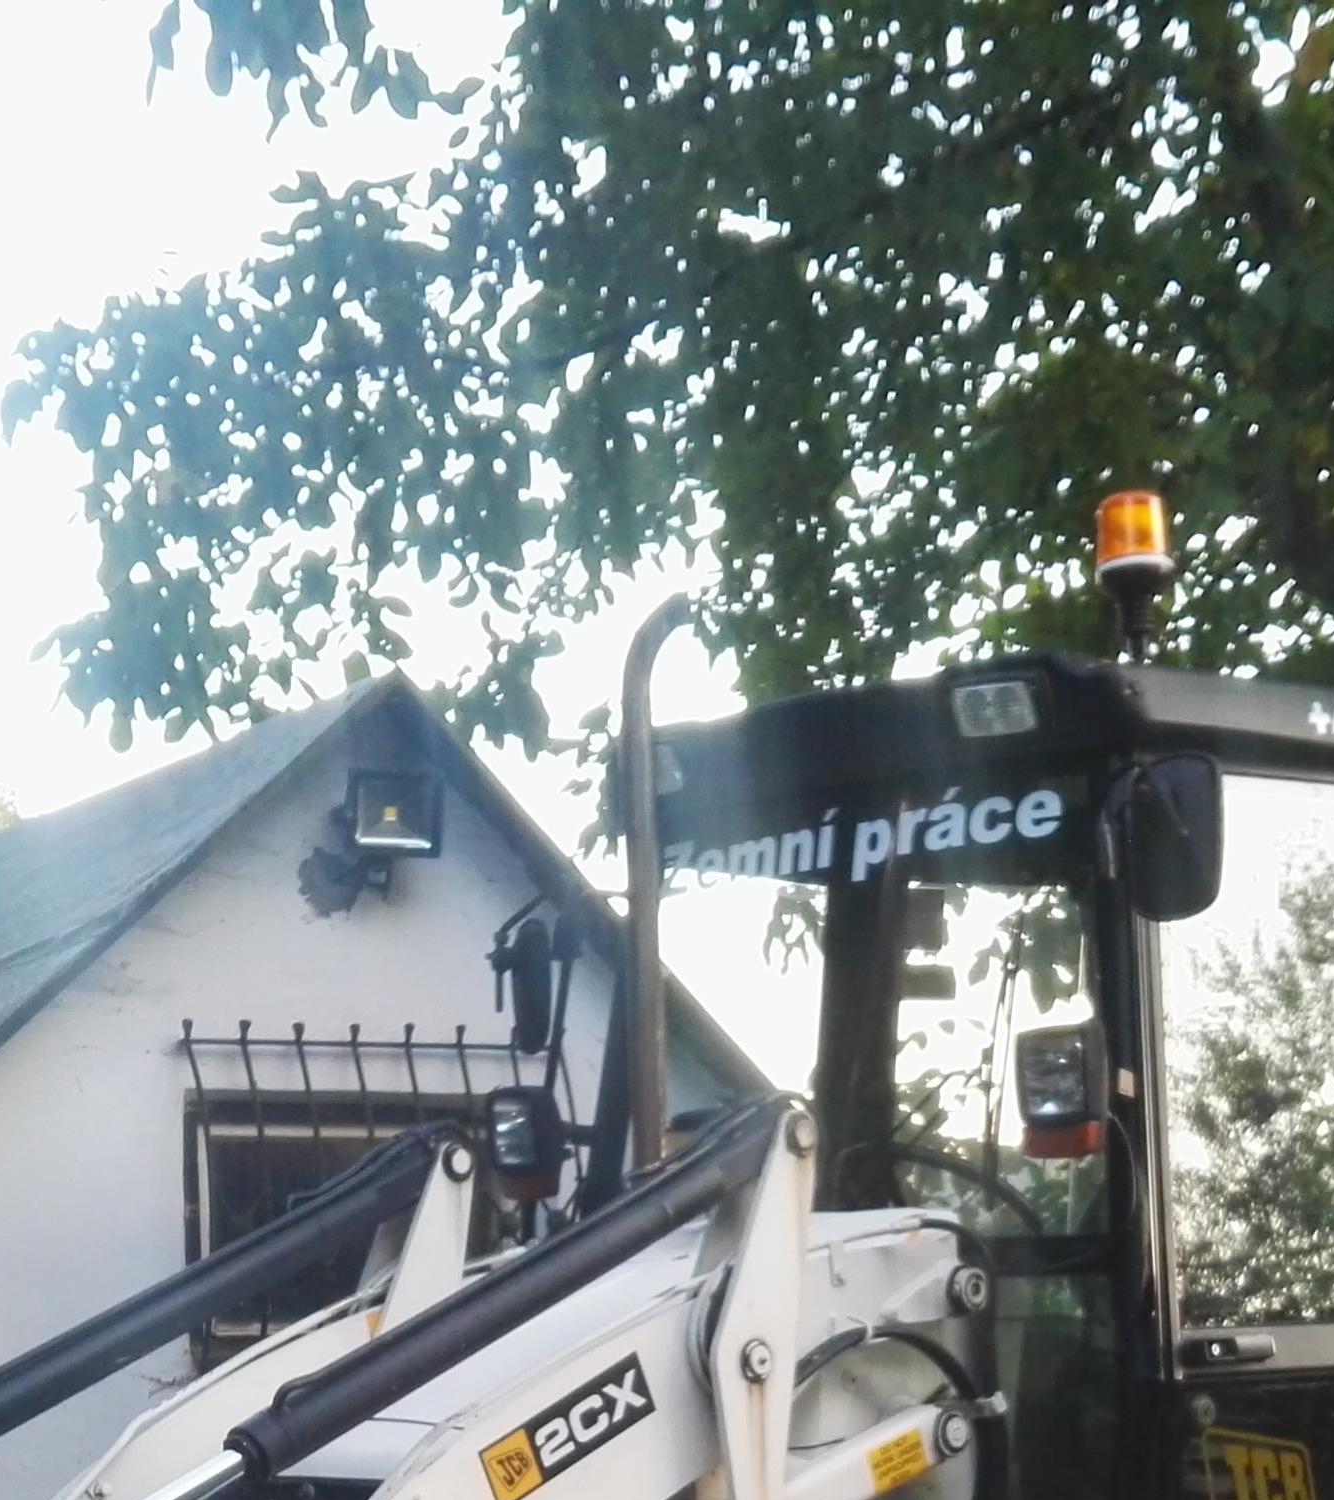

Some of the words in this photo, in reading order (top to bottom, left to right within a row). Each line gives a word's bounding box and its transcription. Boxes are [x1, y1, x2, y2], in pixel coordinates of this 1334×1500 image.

[851, 785, 1064, 882] práce
[496, 1450, 530, 1488] JCB
[534, 1367, 648, 1469] 2CX
